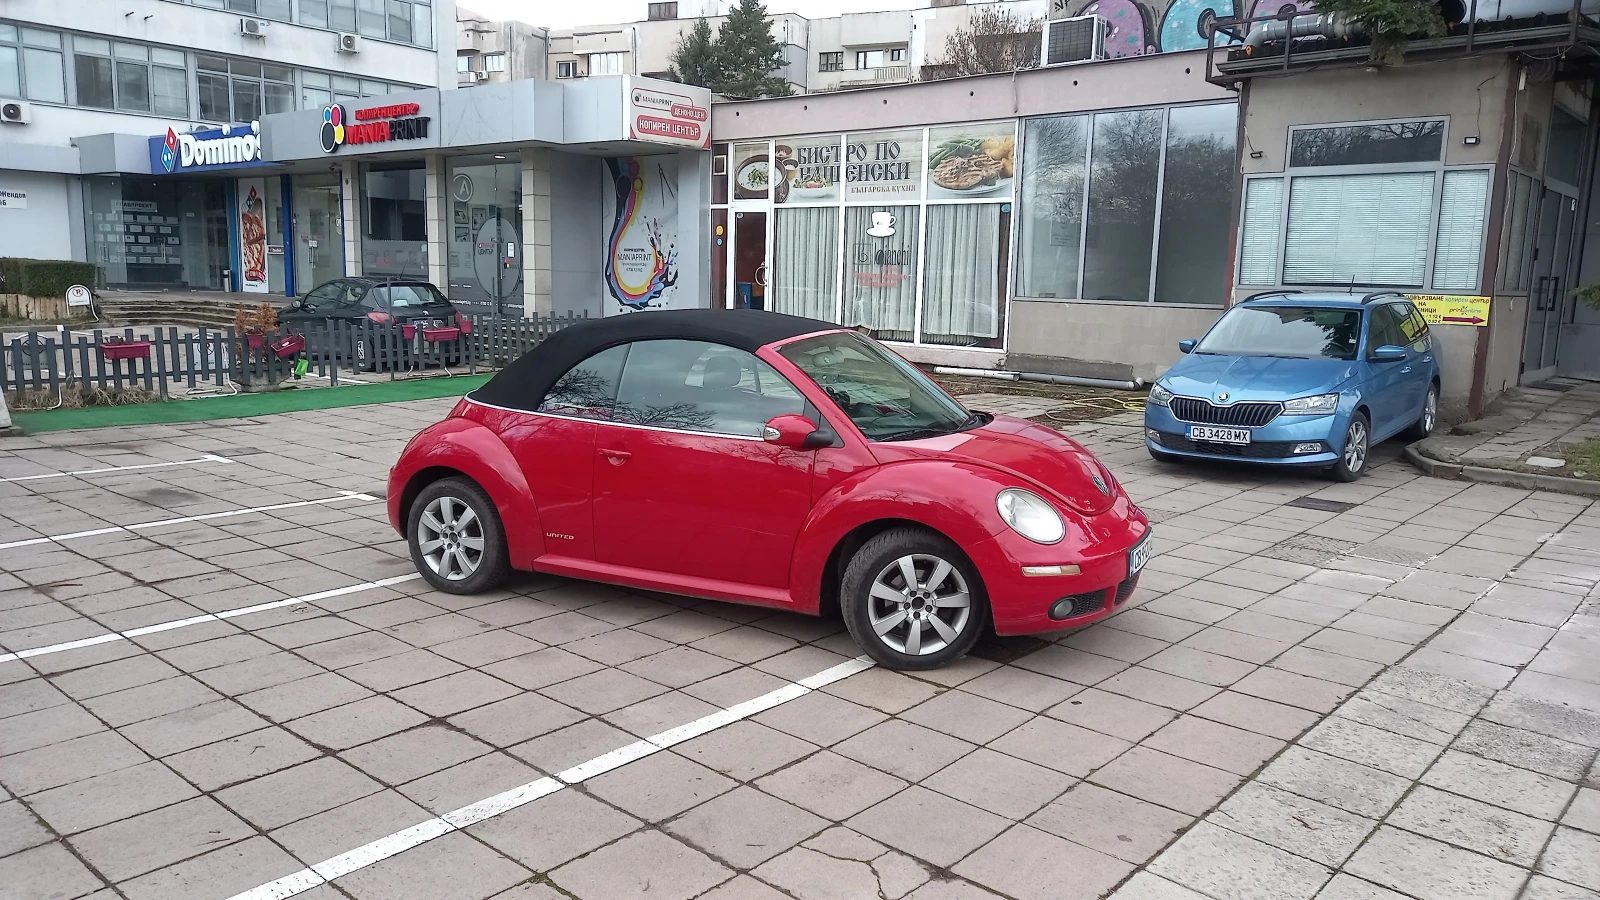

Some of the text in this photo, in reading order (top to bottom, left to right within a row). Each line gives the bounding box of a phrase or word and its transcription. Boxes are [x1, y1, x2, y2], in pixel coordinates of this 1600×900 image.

[642, 95, 673, 107] MANIAPRINT
[355, 103, 419, 121] КОПИРЕН ЦЕНТЪР
[674, 108, 705, 119] ДЕНОНОЩЕН
[346, 117, 431, 146] MANIAPRINT
[639, 119, 699, 137] КОПИРЕН ЦЕНТЪР
[797, 141, 901, 164] БИСТРО ПО
[800, 162, 911, 183] НАШЕНСКИ
[851, 185, 917, 194] БЪЛГАРСКА КУХНЯ
[617, 253, 653, 261] MANIAPRINT
[874, 242, 909, 266] bianchi
[1192, 427, 1249, 442] CB 3428 MX
[546, 532, 575, 540] UNITED
